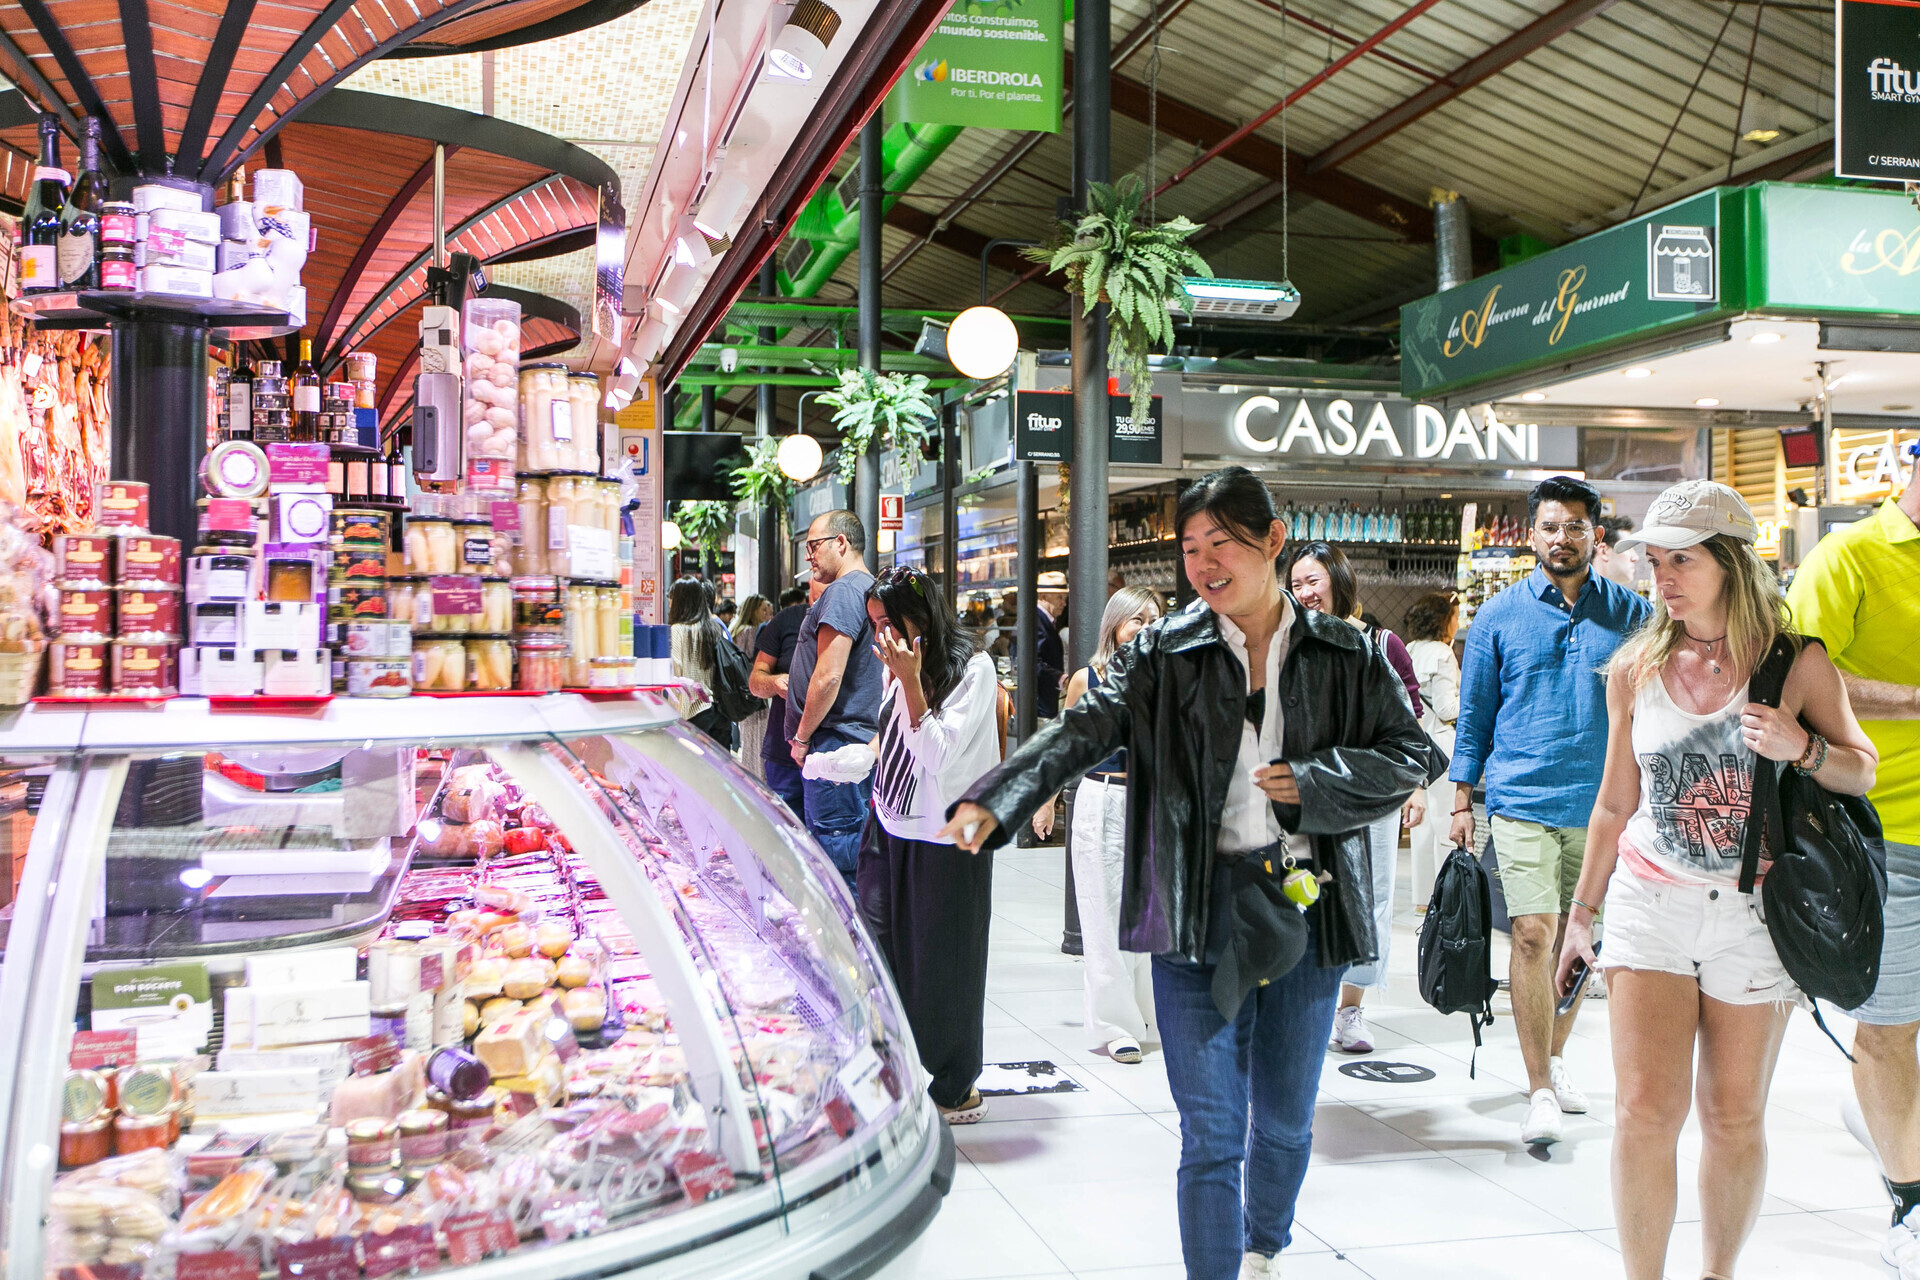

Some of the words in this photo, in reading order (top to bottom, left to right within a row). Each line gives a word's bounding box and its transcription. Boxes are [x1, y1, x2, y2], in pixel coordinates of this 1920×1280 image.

[943, 12, 968, 23] ntos
[968, 14, 1039, 28] construimos
[938, 25, 982, 38] mundo
[983, 28, 1048, 42] sostenible.
[950, 67, 1043, 87] IBERDROLA
[950, 87, 966, 98] Por
[968, 88, 977, 98] ti.
[979, 89, 994, 100] Por
[996, 90, 1005, 100] el
[1006, 90, 1043, 103] planeta.
[1871, 91, 1902, 102] SMART
[1868, 155, 1879, 166] C/
[1532, 297, 1558, 326] del
[1549, 264, 1630, 346] Gourmet
[1443, 284, 1530, 358] Alacena
[1447, 316, 1460, 339] la
[1026, 412, 1062, 430] fitup
[1115, 416, 1125, 424] TU
[1233, 395, 1403, 457] CASA
[1413, 402, 1539, 463] DANI
